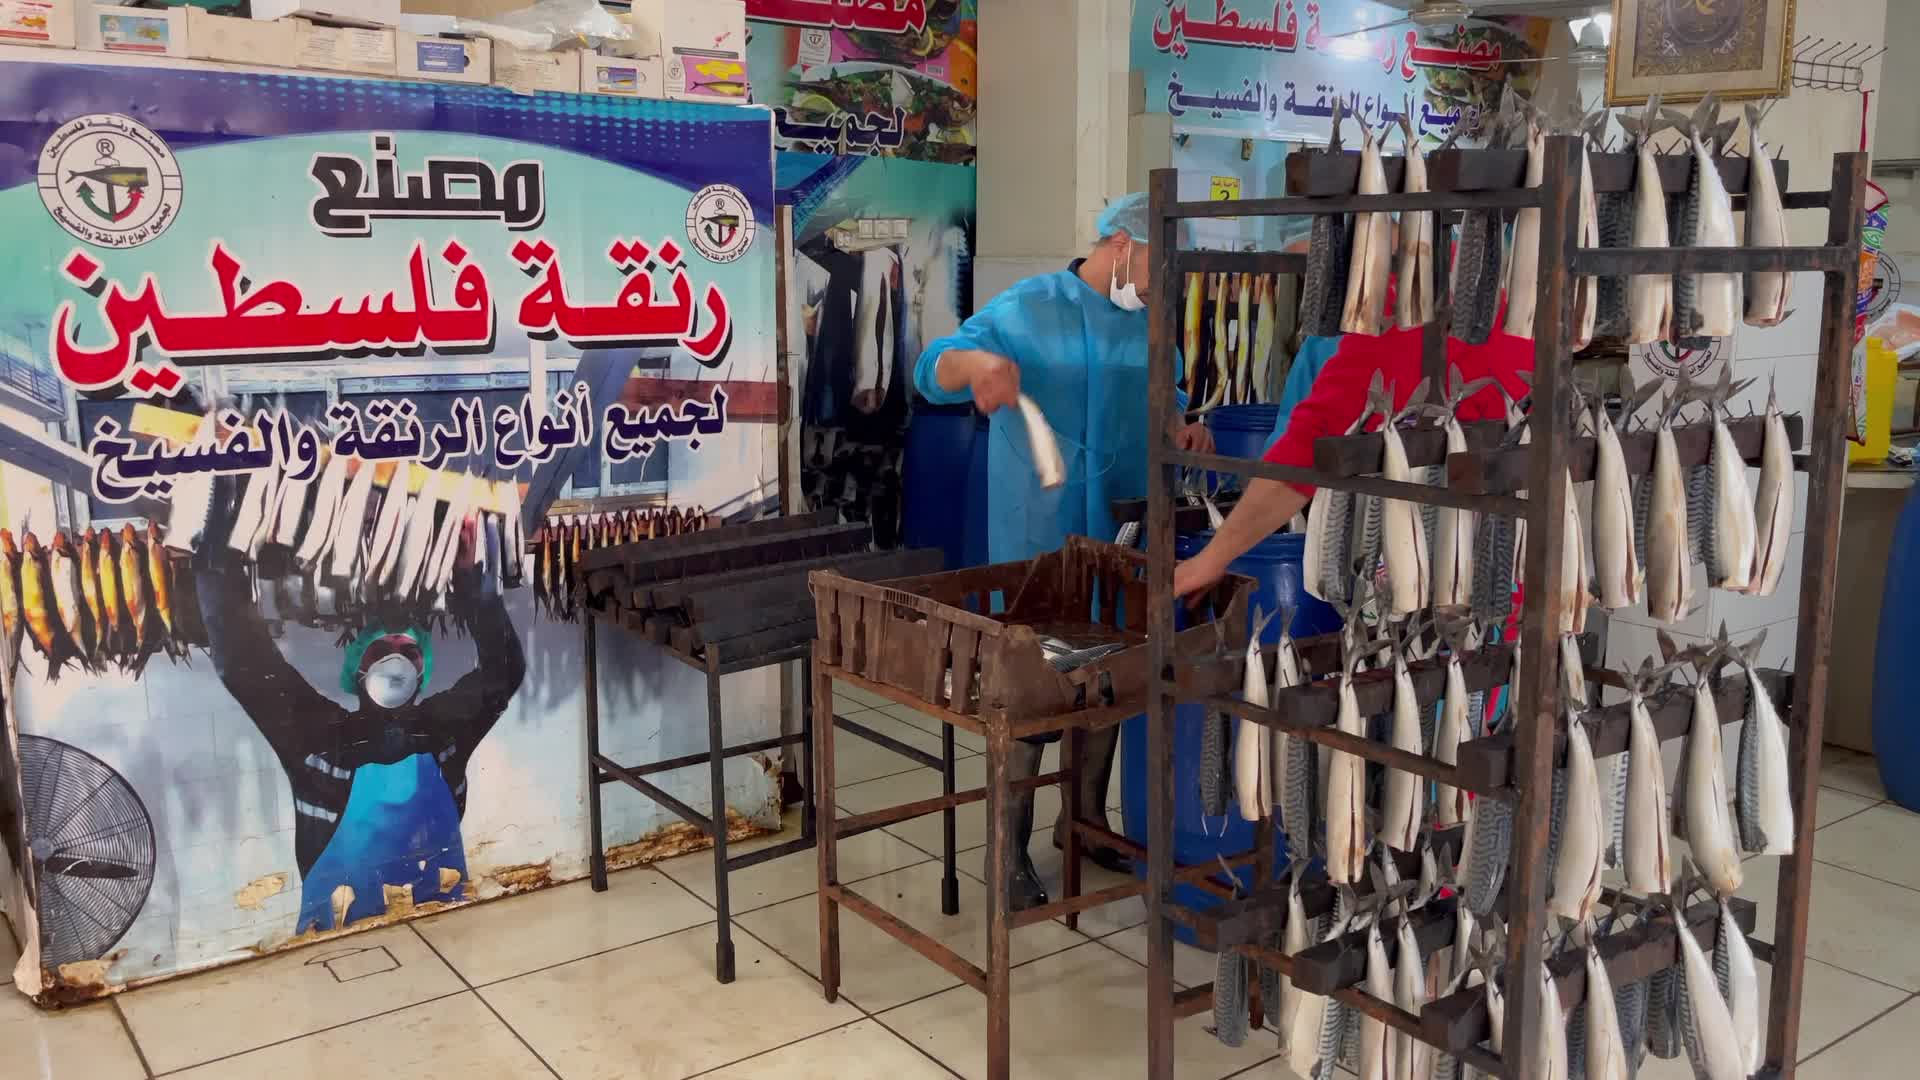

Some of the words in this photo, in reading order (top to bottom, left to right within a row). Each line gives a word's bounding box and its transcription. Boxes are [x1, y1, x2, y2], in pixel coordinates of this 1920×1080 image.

[1152, 0, 1299, 58] فلسطين
[1167, 72, 1278, 120] والفسيخ
[47, 122, 86, 158] فلسطين
[130, 128, 165, 158] مصنع
[312, 133, 544, 237] مصنع
[53, 206, 93, 240] والفسيخ
[95, 231, 127, 246] الرنقة
[150, 203, 172, 234] لجميع
[51, 237, 497, 398] فلسطين
[511, 237, 733, 367] رنقة
[92, 408, 321, 504] والفسيخ
[327, 397, 485, 471] الرنقة
[494, 381, 594, 469] أنواع
[605, 385, 728, 463] لجميع
